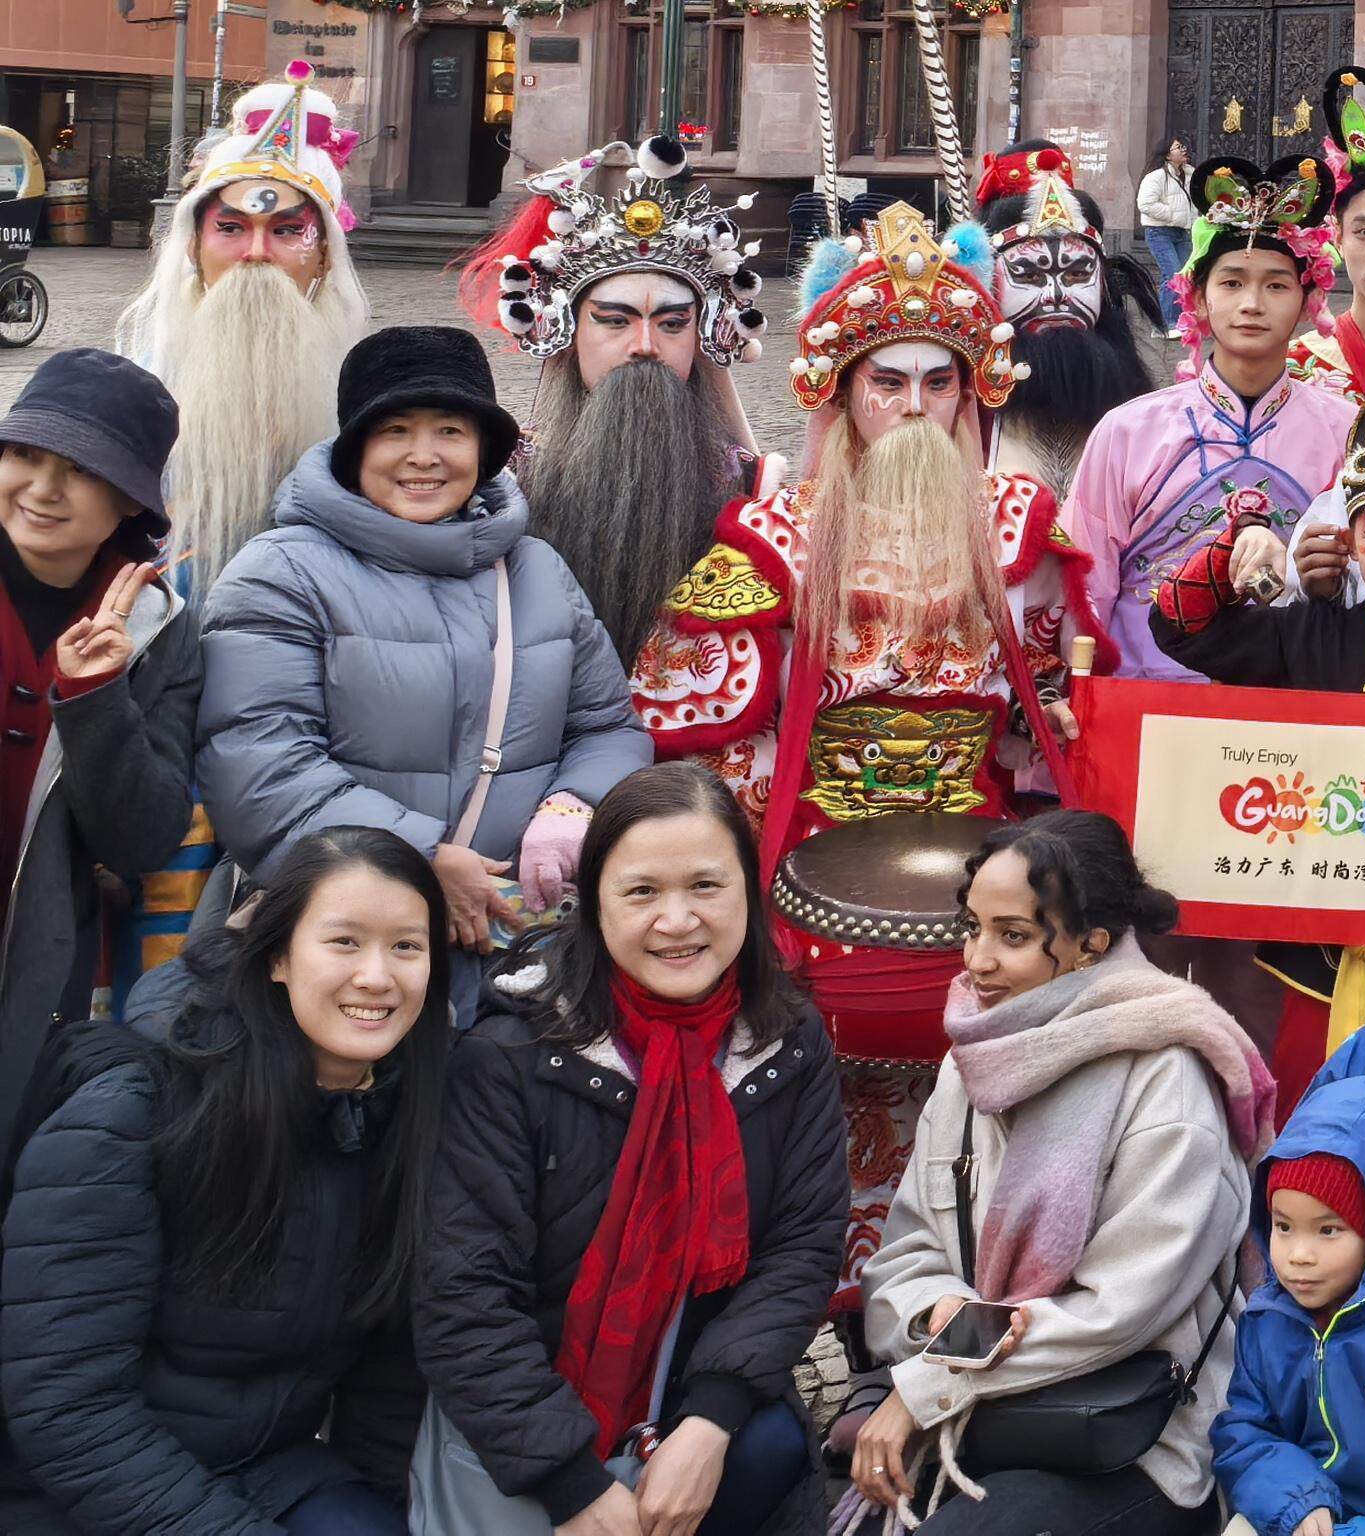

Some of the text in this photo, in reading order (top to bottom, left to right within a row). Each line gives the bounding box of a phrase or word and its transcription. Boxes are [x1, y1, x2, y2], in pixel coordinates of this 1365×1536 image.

[524, 76, 534, 86] 19
[1221, 745, 1298, 767] Truly Enjoy
[1213, 856, 1295, 878] 活力广东
